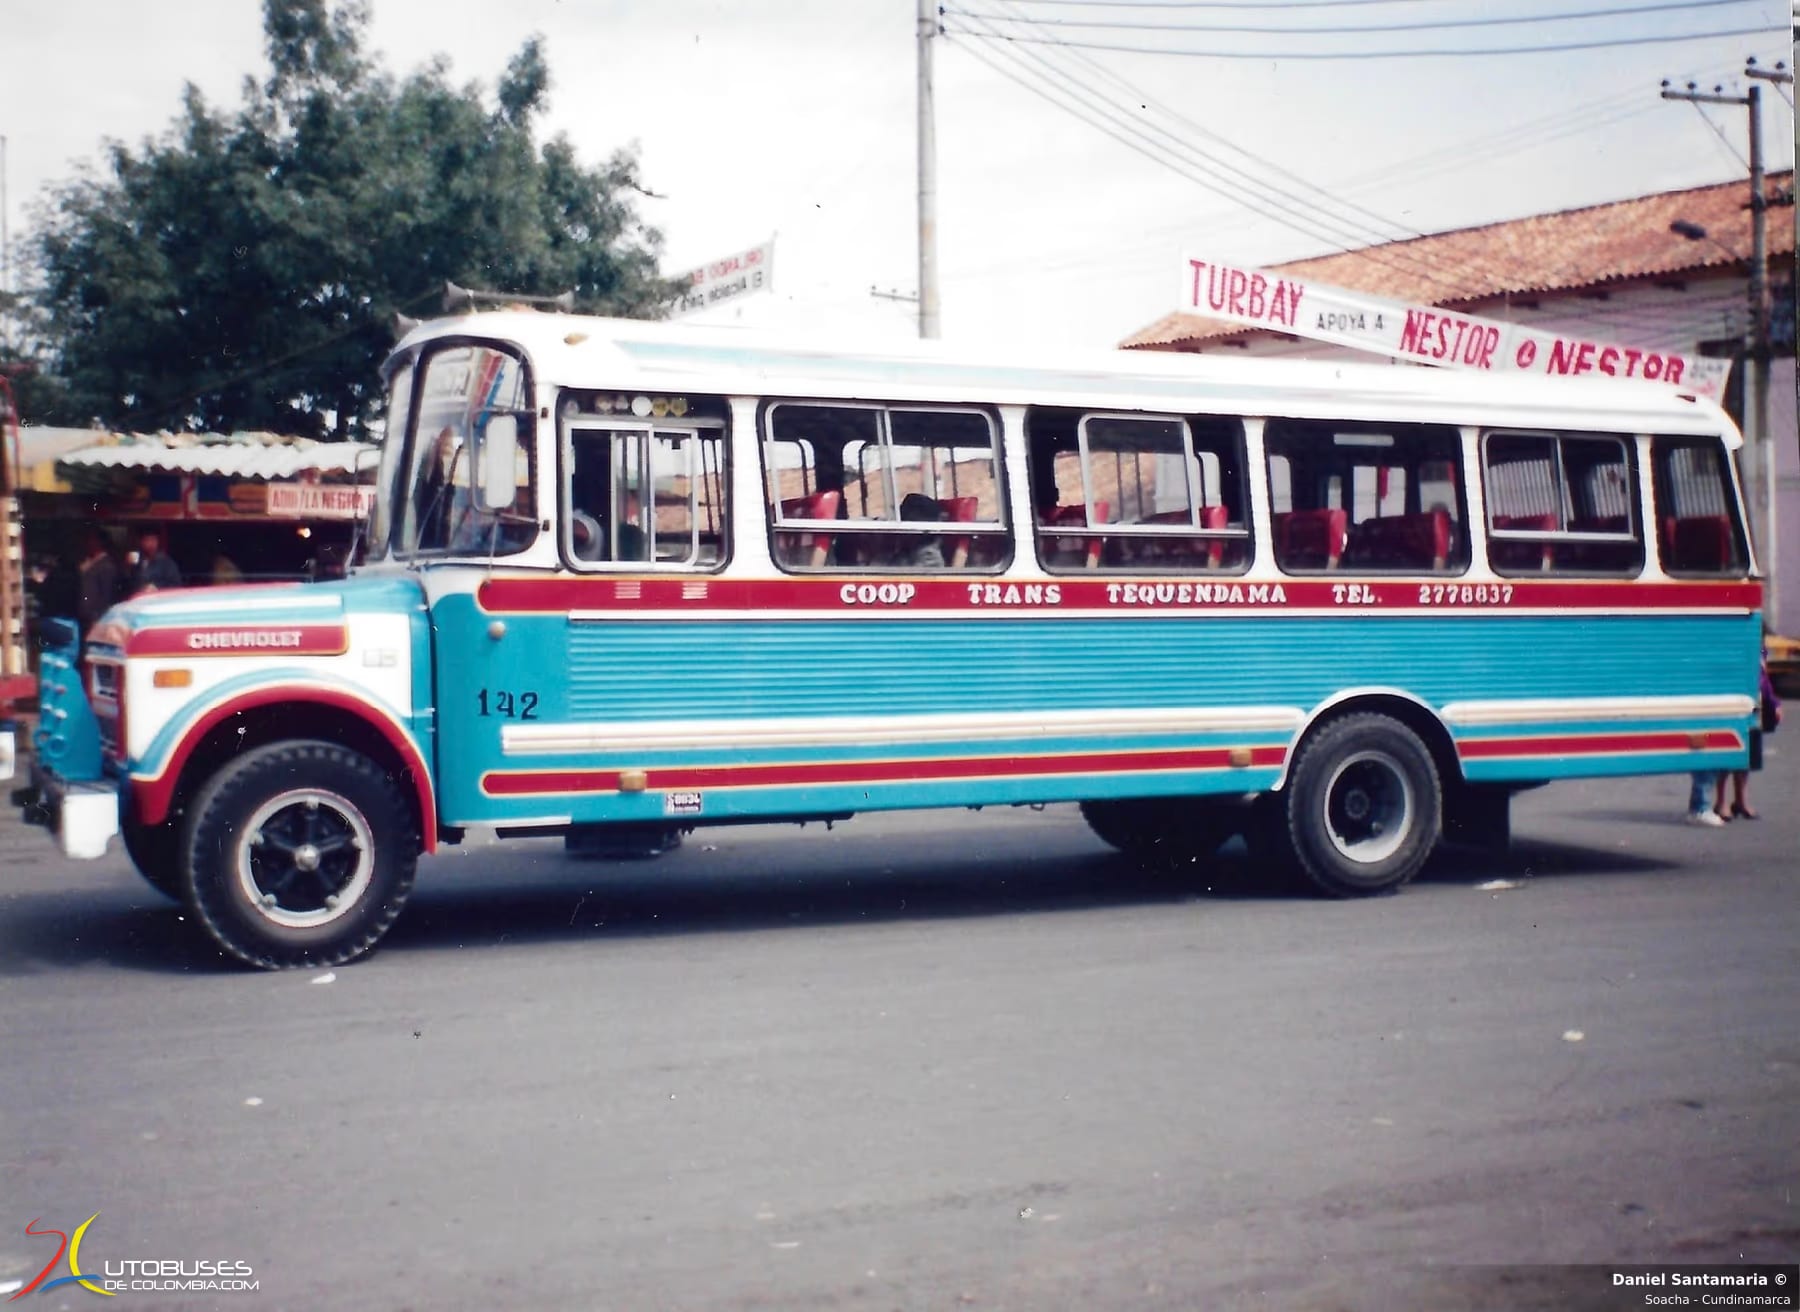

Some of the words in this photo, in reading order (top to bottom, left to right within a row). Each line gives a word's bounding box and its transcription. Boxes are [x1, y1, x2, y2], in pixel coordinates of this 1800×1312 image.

[1189, 259, 1304, 327] TURBAY
[1316, 312, 1366, 332] APOYA
[1374, 313, 1384, 331] A
[1400, 309, 1500, 370] NESTOR
[1546, 339, 1685, 385] NESTOR
[839, 583, 915, 605] COOP
[967, 583, 1062, 605] TRANS
[1105, 584, 1287, 605] TEQUENDAMA
[1332, 584, 1382, 604] TEL.
[188, 631, 303, 649] CHEVROLET
[477, 688, 539, 720] 142
